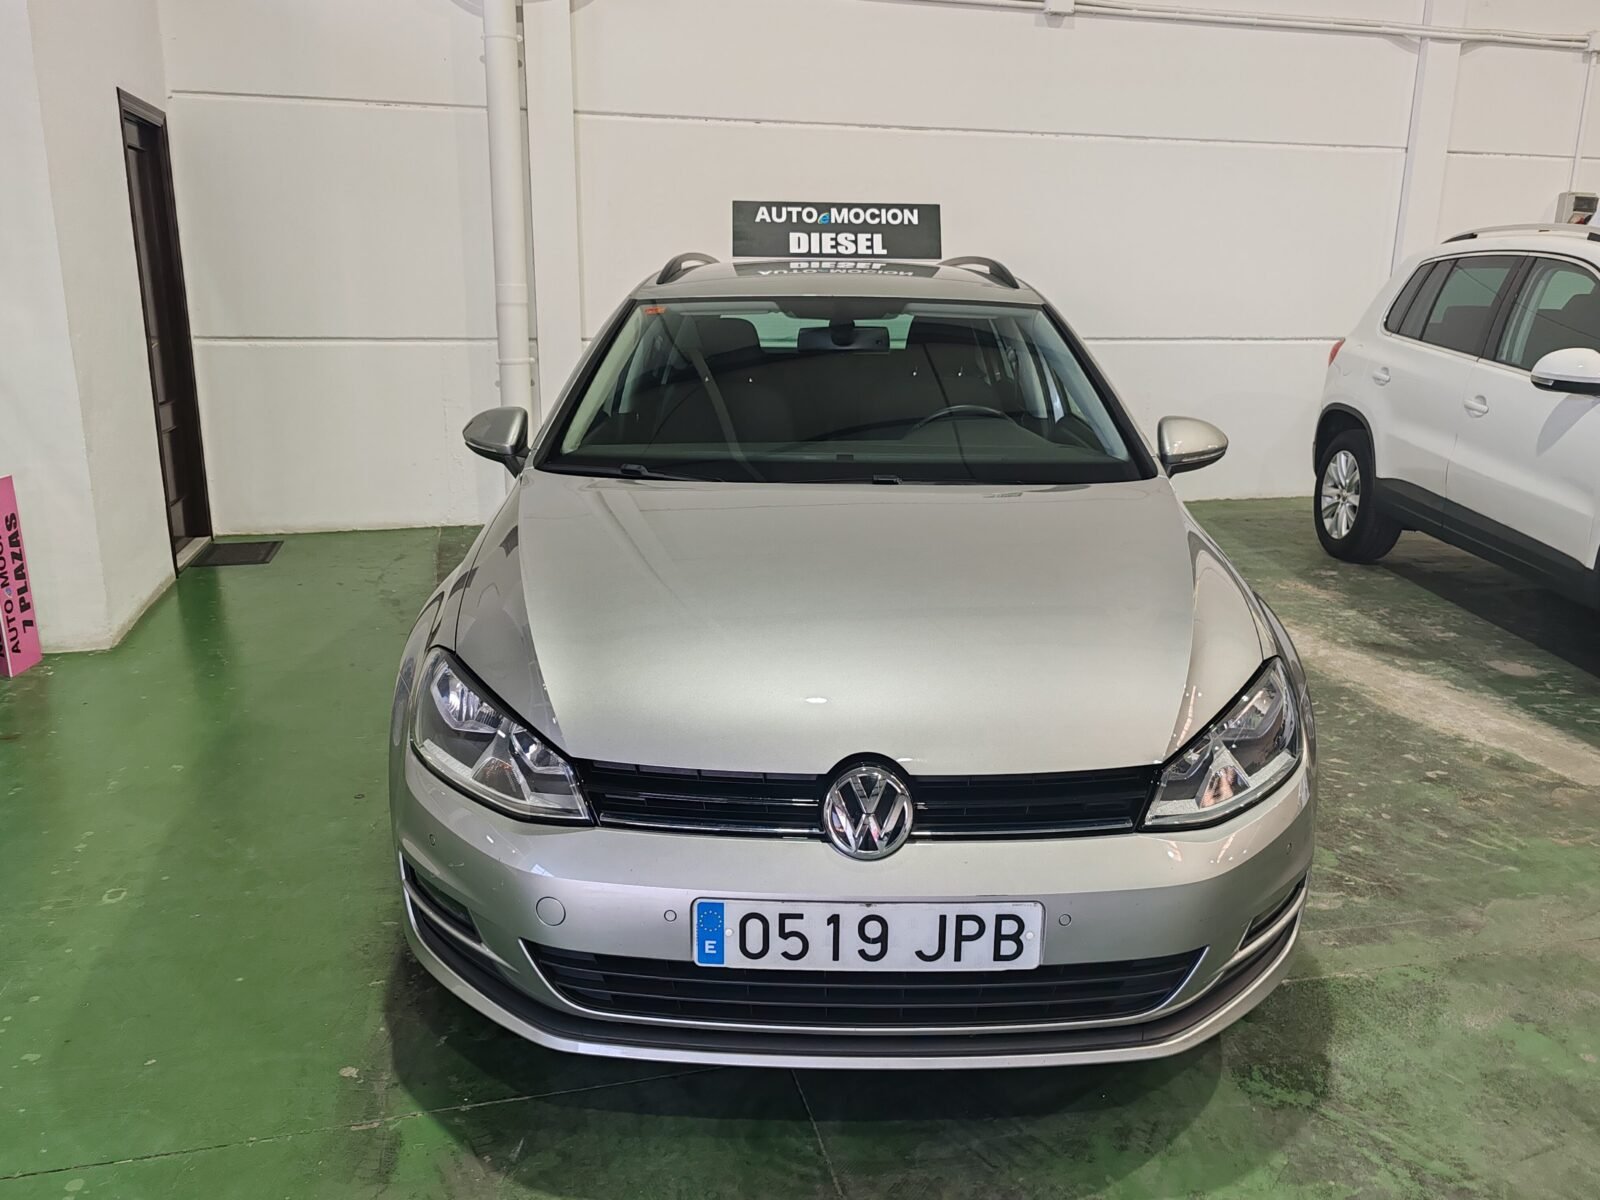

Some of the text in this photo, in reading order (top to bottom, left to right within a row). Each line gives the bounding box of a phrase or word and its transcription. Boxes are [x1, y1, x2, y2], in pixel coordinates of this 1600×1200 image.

[789, 232, 887, 255] DIESEL
[5, 512, 34, 633] 7 PLAZAS
[704, 940, 717, 954] E
[738, 912, 1026, 962] 0519 JPB
